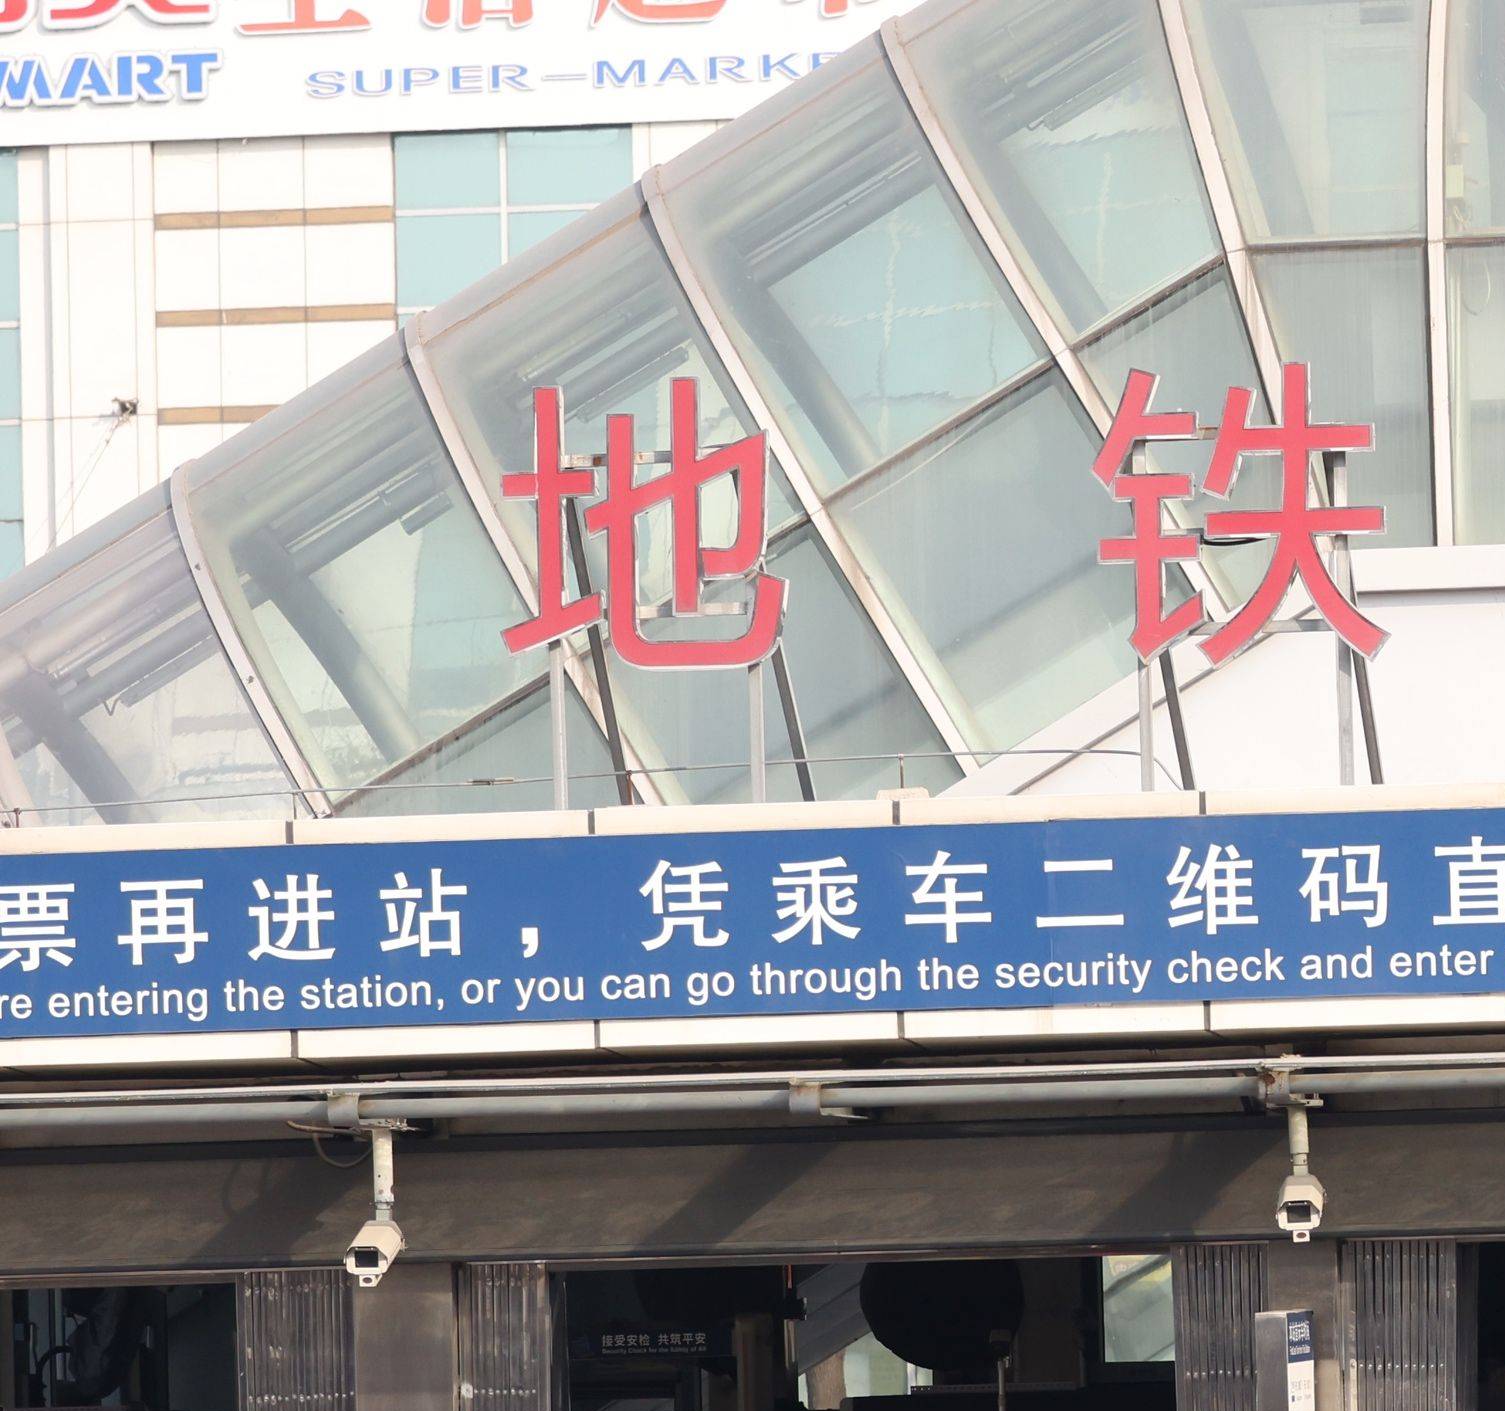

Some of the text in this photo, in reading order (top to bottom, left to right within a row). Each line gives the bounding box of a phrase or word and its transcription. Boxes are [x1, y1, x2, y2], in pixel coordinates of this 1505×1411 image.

[48, 982, 207, 1021] entering
[224, 979, 284, 1012] the
[301, 975, 443, 1010] station,
[462, 979, 501, 1004] or
[515, 977, 584, 1011] you
[601, 974, 670, 1000] can
[687, 972, 734, 1005] go
[750, 959, 901, 1000] through
[918, 957, 979, 990] the
[996, 953, 1152, 993] security
[1168, 948, 1285, 983] check
[1301, 945, 1372, 980] and
[1390, 944, 1494, 977] enter
[601, 1334, 650, 1347] 接受安检
